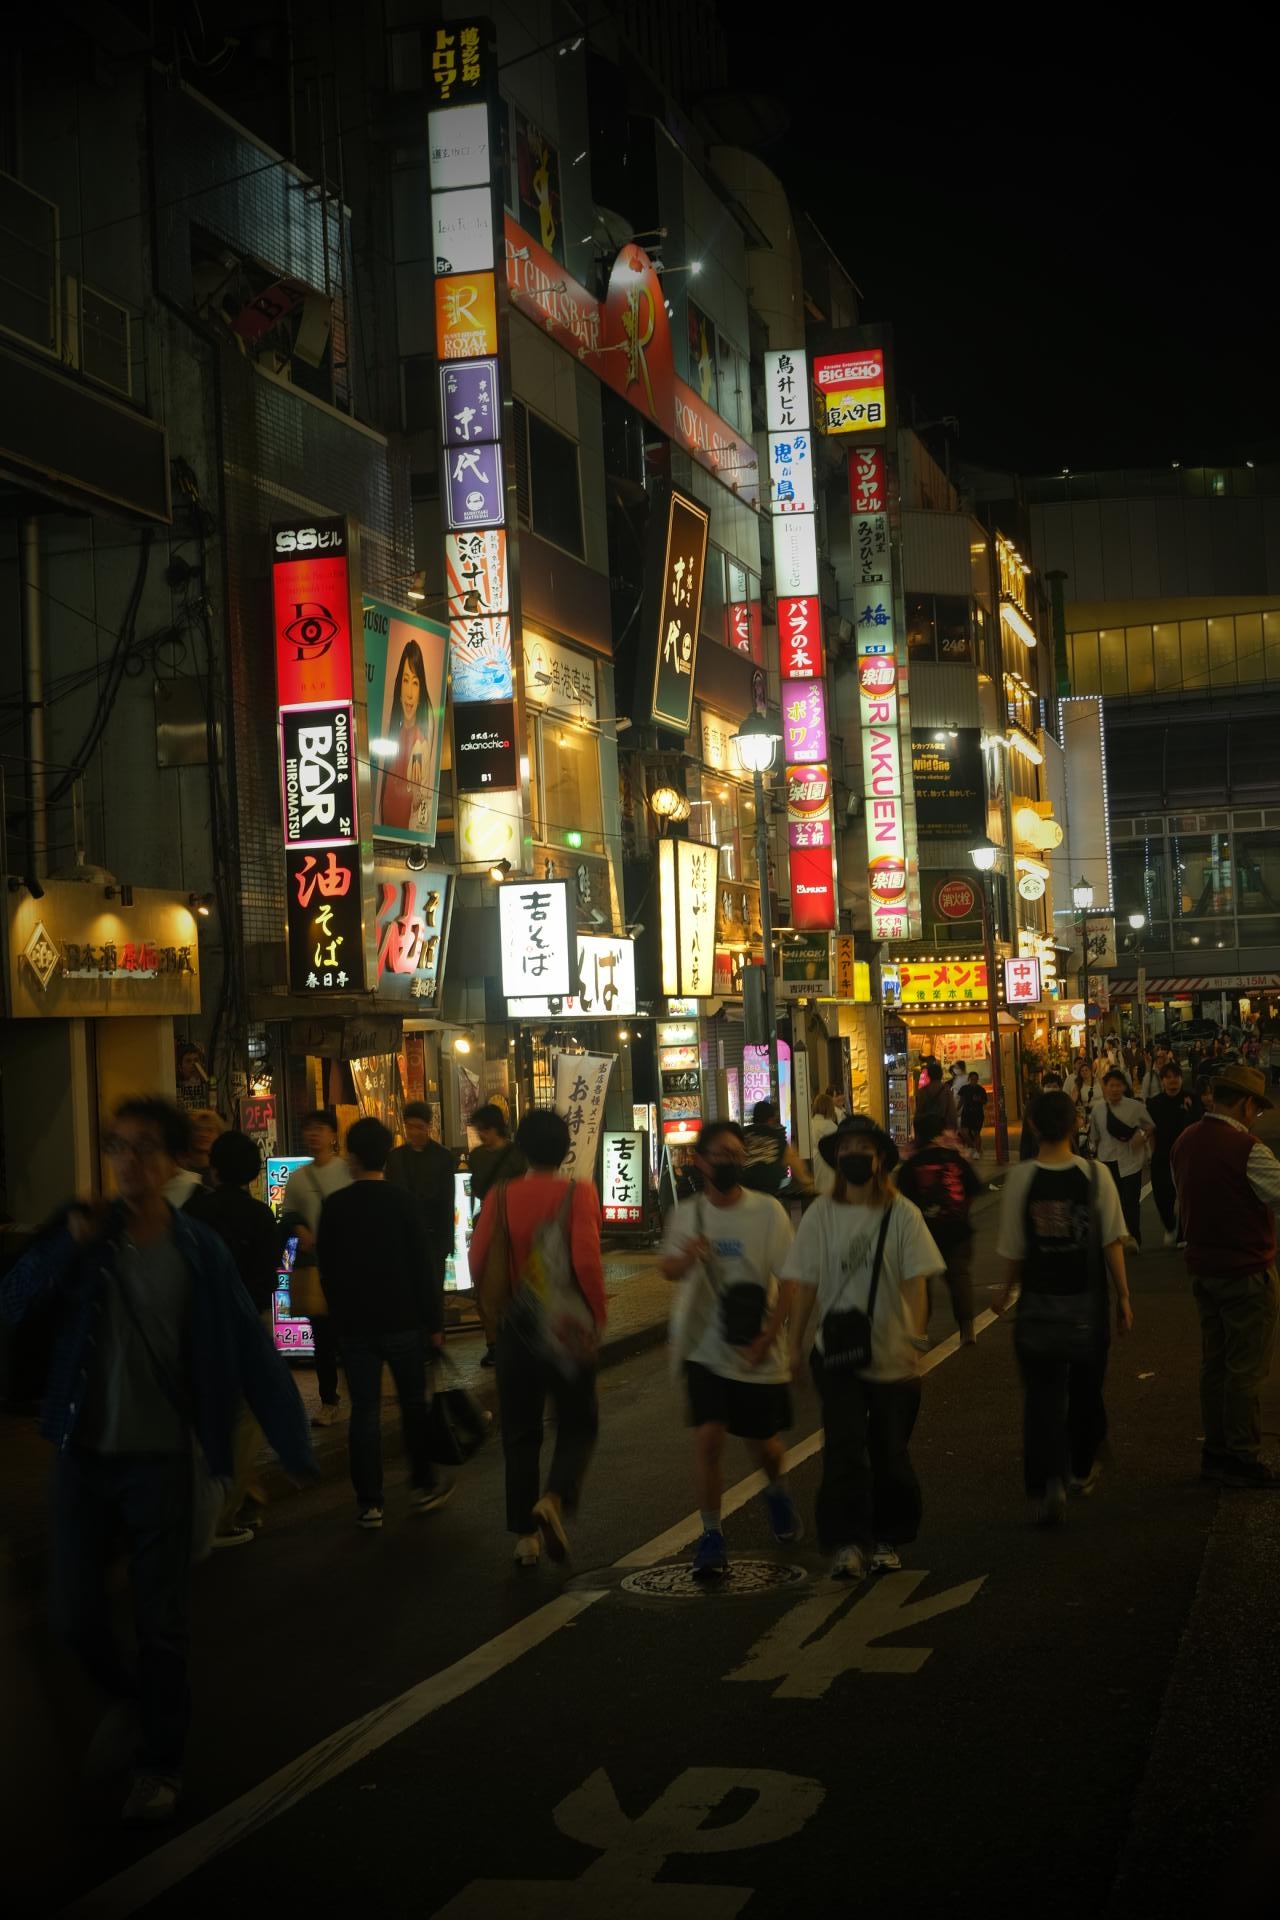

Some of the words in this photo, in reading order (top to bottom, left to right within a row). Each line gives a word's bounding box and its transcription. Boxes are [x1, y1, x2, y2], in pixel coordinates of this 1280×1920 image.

[819, 370, 844, 384] BIG
[845, 363, 882, 378] ECHO
[855, 448, 881, 497] マツヤ
[856, 498, 882, 511] ビル
[275, 528, 317, 552] SS
[318, 531, 342, 548] ビル
[858, 604, 890, 625] 梅
[788, 600, 812, 667] バラの木
[860, 668, 896, 687] 楽園
[298, 725, 336, 829] BAR
[337, 773, 349, 784] &
[481, 773, 492, 782] B1
[868, 702, 897, 842] RAKUEN
[285, 758, 301, 839] HIROMATSU
[338, 816, 353, 836] 2F
[795, 832, 825, 846] 左折
[871, 870, 906, 890] 楽園
[943, 890, 971, 908] 消火栓
[295, 852, 352, 968] 油そば
[519, 890, 552, 976] 吉そば
[876, 926, 903, 938] 左折
[305, 970, 350, 987] 春日亭
[1012, 963, 1034, 998] 中華
[611, 1137, 656, 1202] 吉そば
[605, 1206, 641, 1220] 営業中
[284, 1328, 298, 1345] 2F
